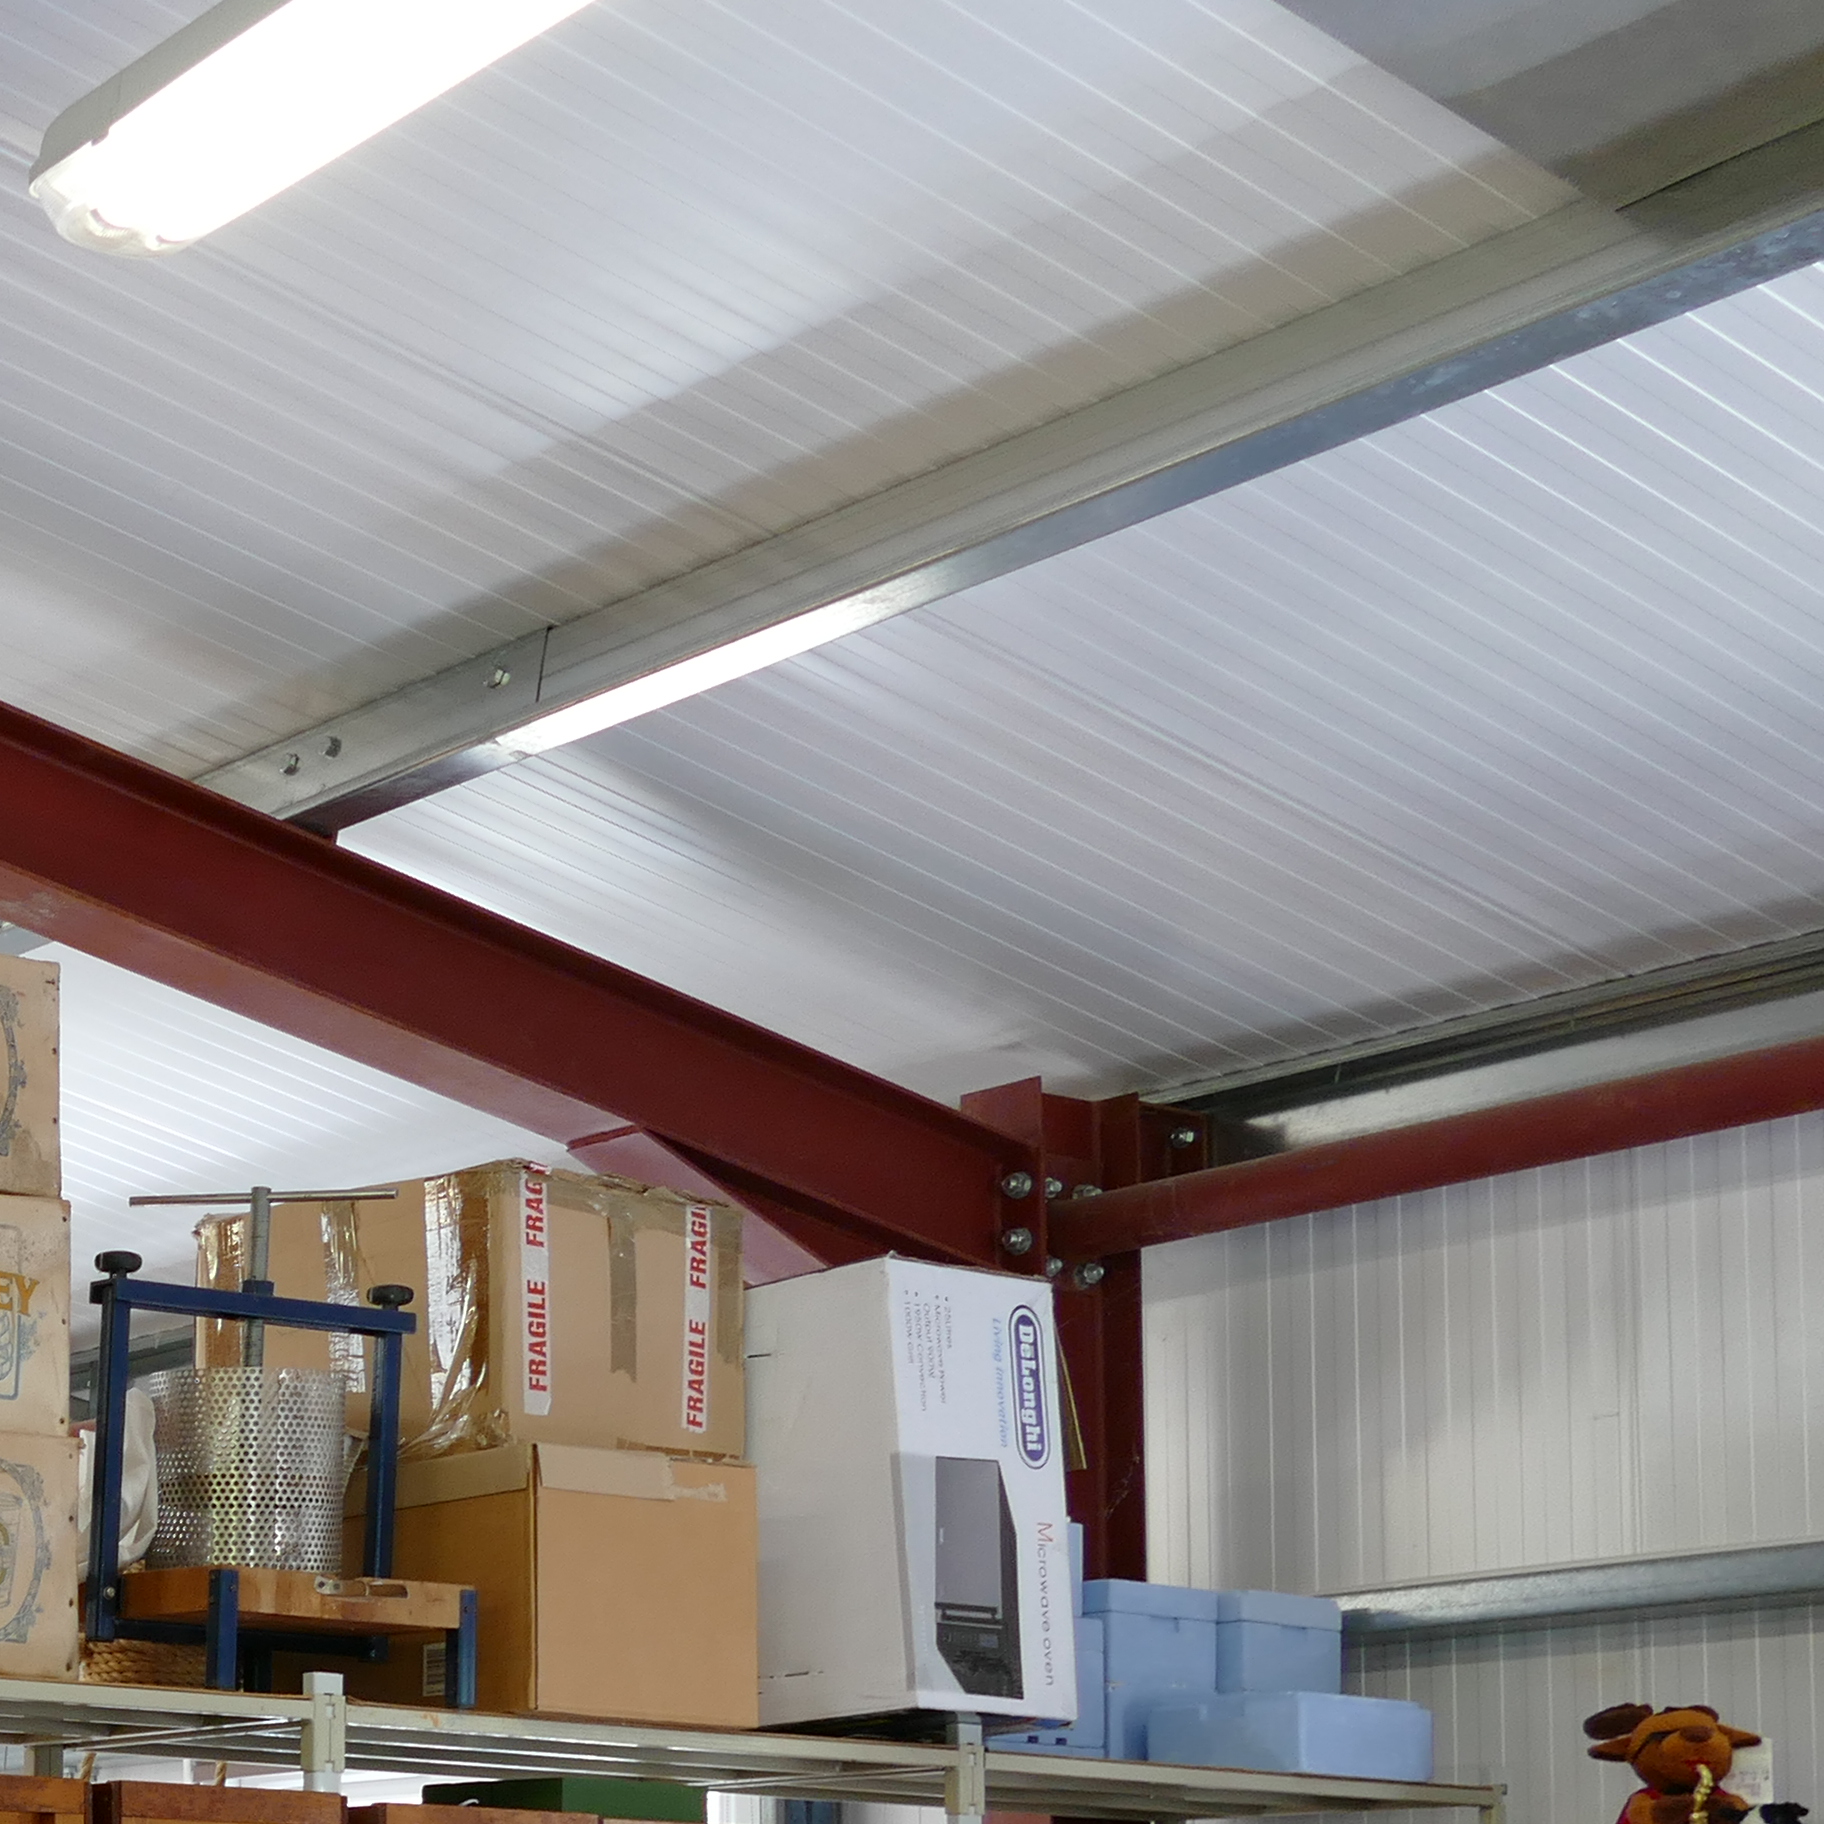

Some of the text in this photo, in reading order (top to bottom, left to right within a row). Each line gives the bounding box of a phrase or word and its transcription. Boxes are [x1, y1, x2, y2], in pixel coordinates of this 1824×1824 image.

[690, 1206, 707, 1289] FRAGI
[527, 1280, 547, 1391] FRAGILE
[687, 1319, 706, 1428] FRAGILE
[992, 1318, 1004, 1362] Living
[1019, 1324, 1042, 1451] DeLonghi
[1037, 1522, 1054, 1685] Microwave oven
